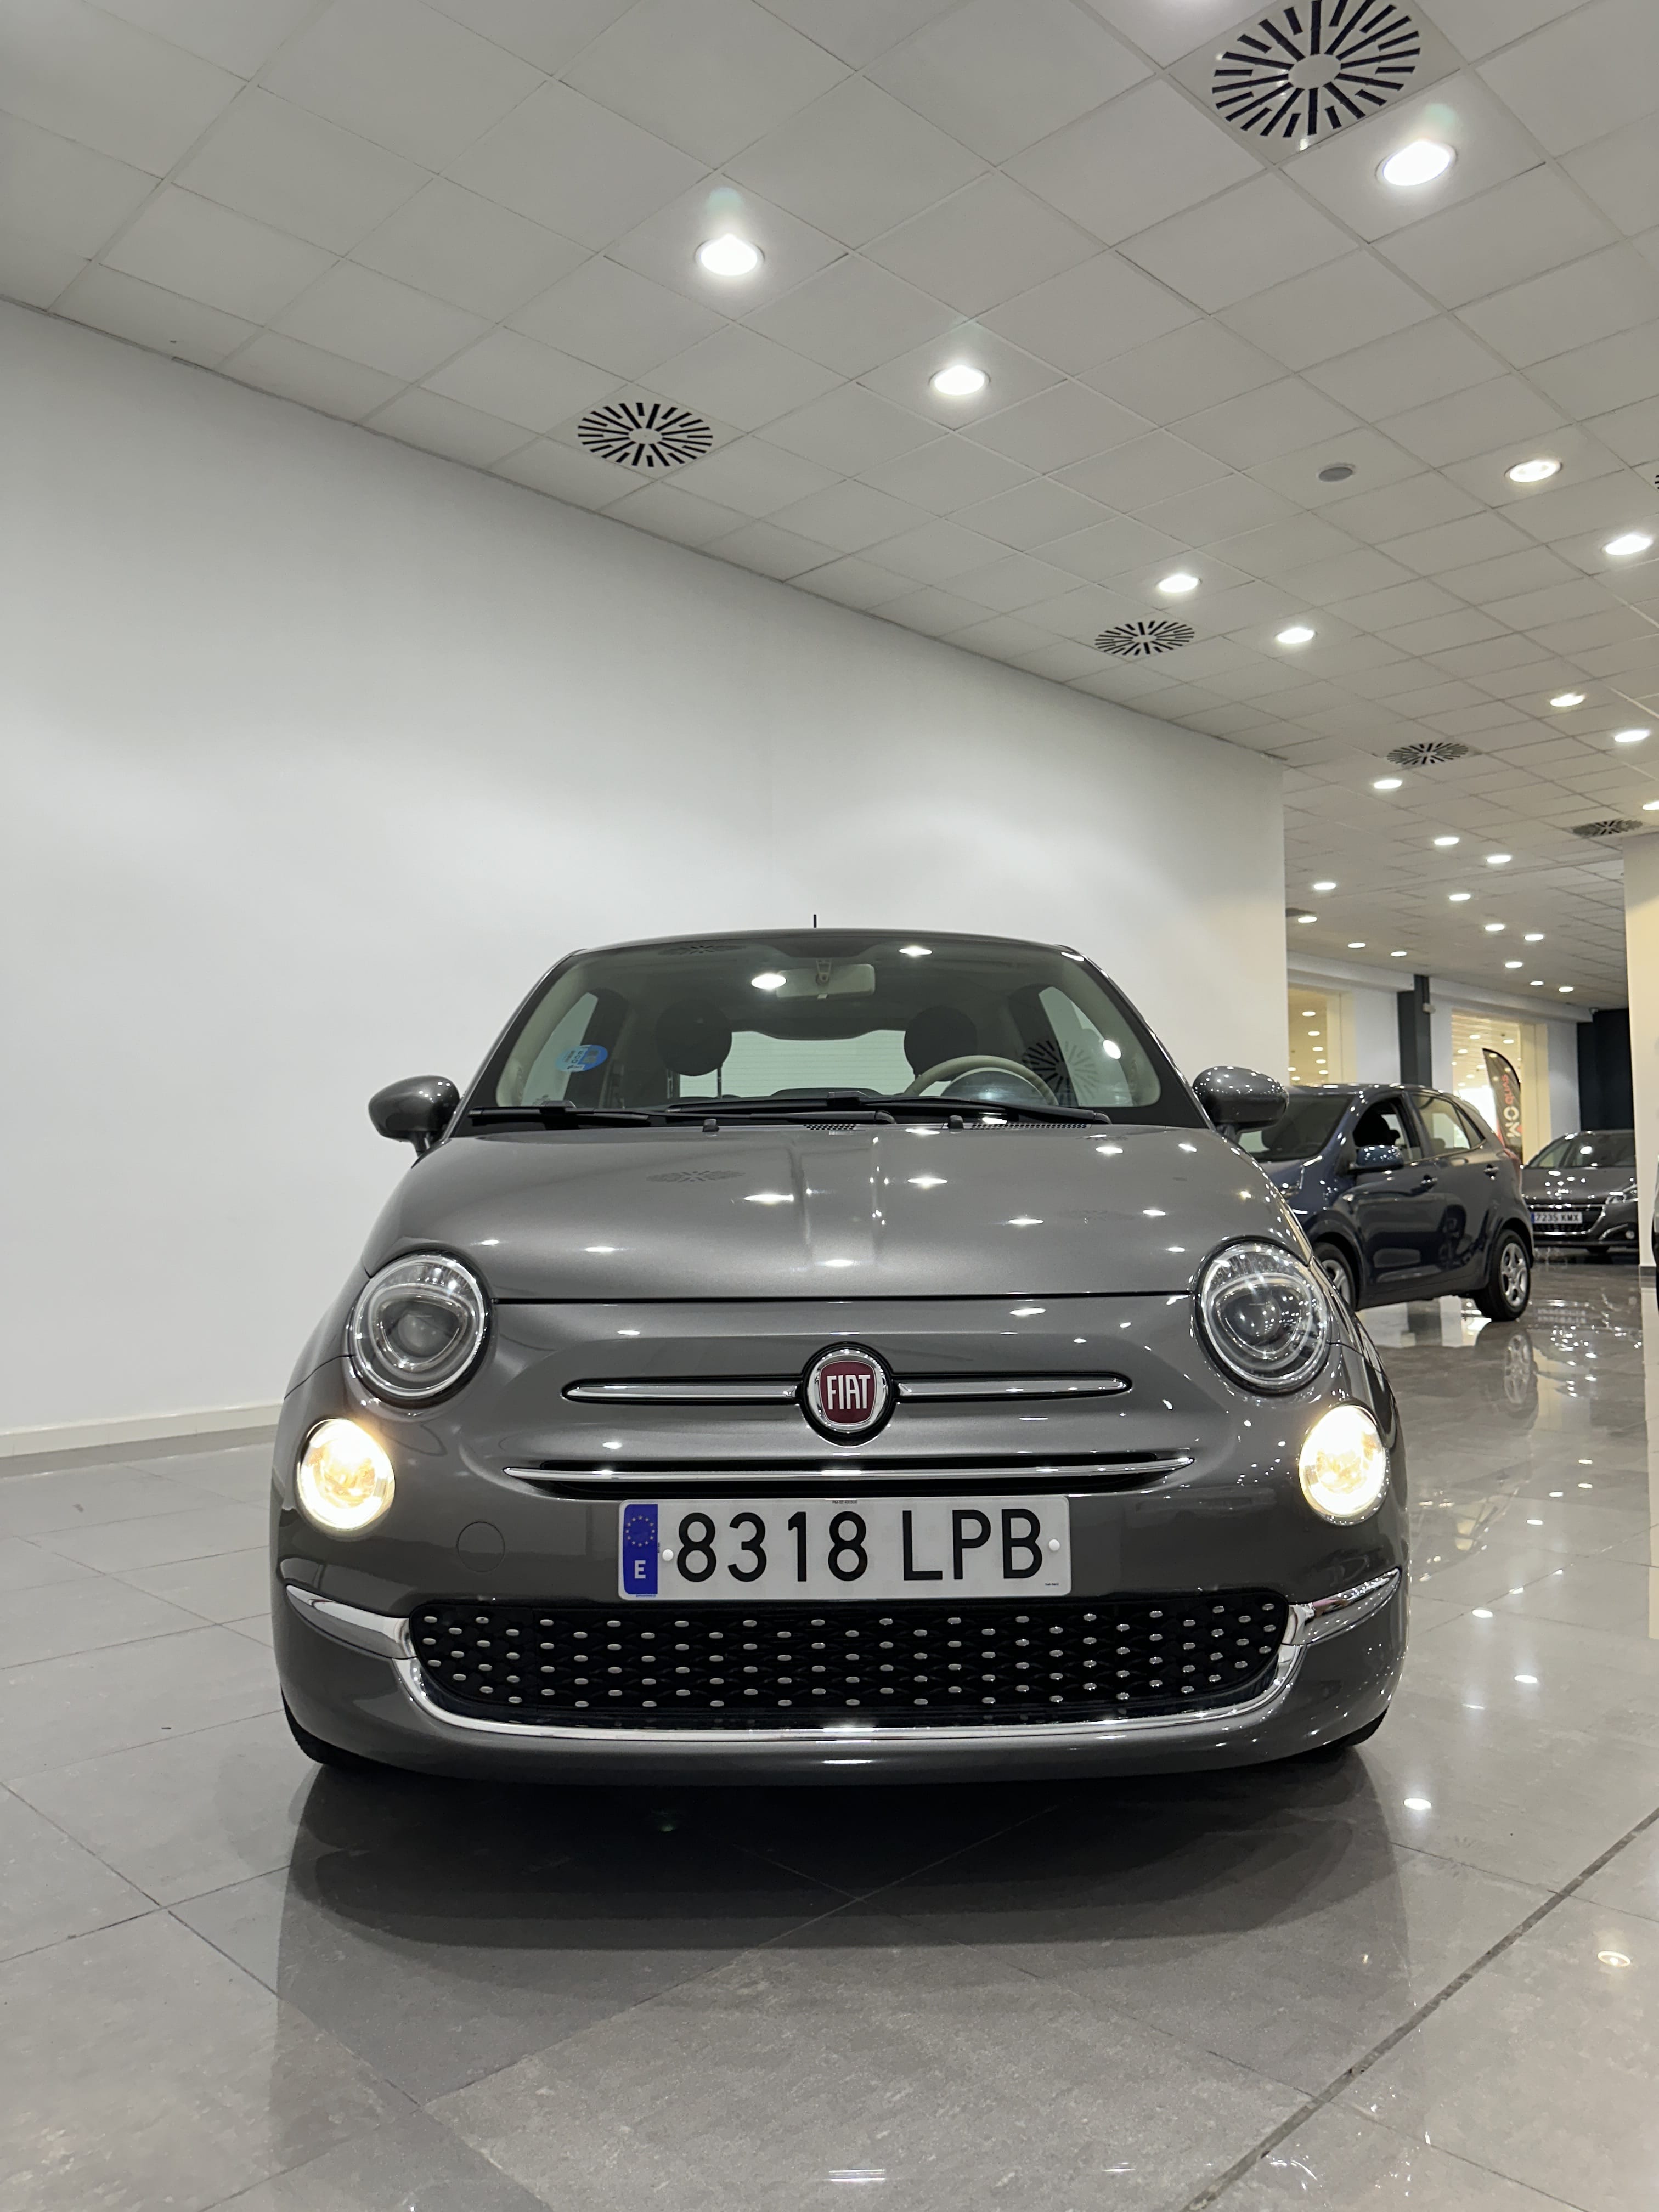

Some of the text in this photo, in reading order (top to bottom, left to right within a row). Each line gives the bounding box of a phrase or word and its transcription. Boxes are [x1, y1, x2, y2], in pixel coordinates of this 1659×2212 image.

[826, 1374, 871, 1410] FIAT
[676, 1508, 1043, 1583] 8318 LPB
[634, 1559, 647, 1579] E
